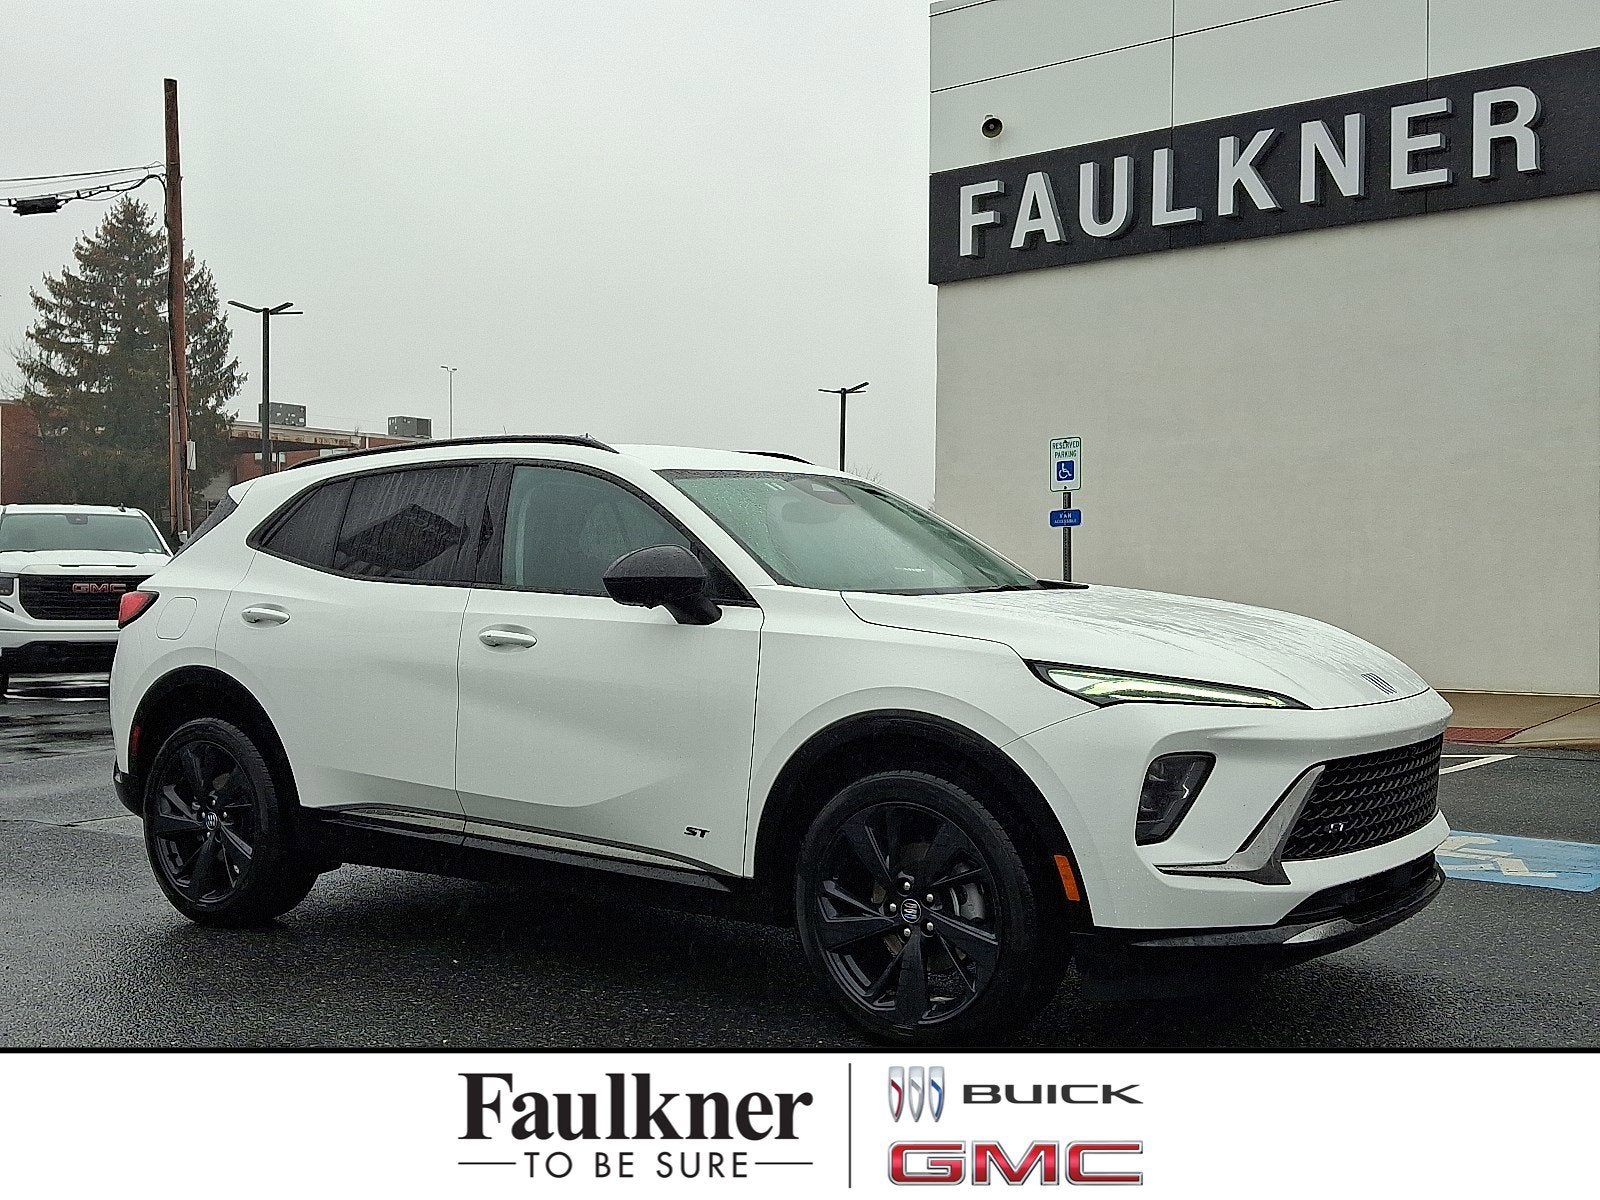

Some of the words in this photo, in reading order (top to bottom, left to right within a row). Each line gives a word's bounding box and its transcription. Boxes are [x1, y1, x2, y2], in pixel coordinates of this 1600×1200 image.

[959, 85, 1541, 257] FAULKNER
[1052, 441, 1079, 449] RESERVED
[1054, 450, 1077, 458] PARKING
[73, 583, 126, 593] GMC
[684, 826, 710, 838] ST
